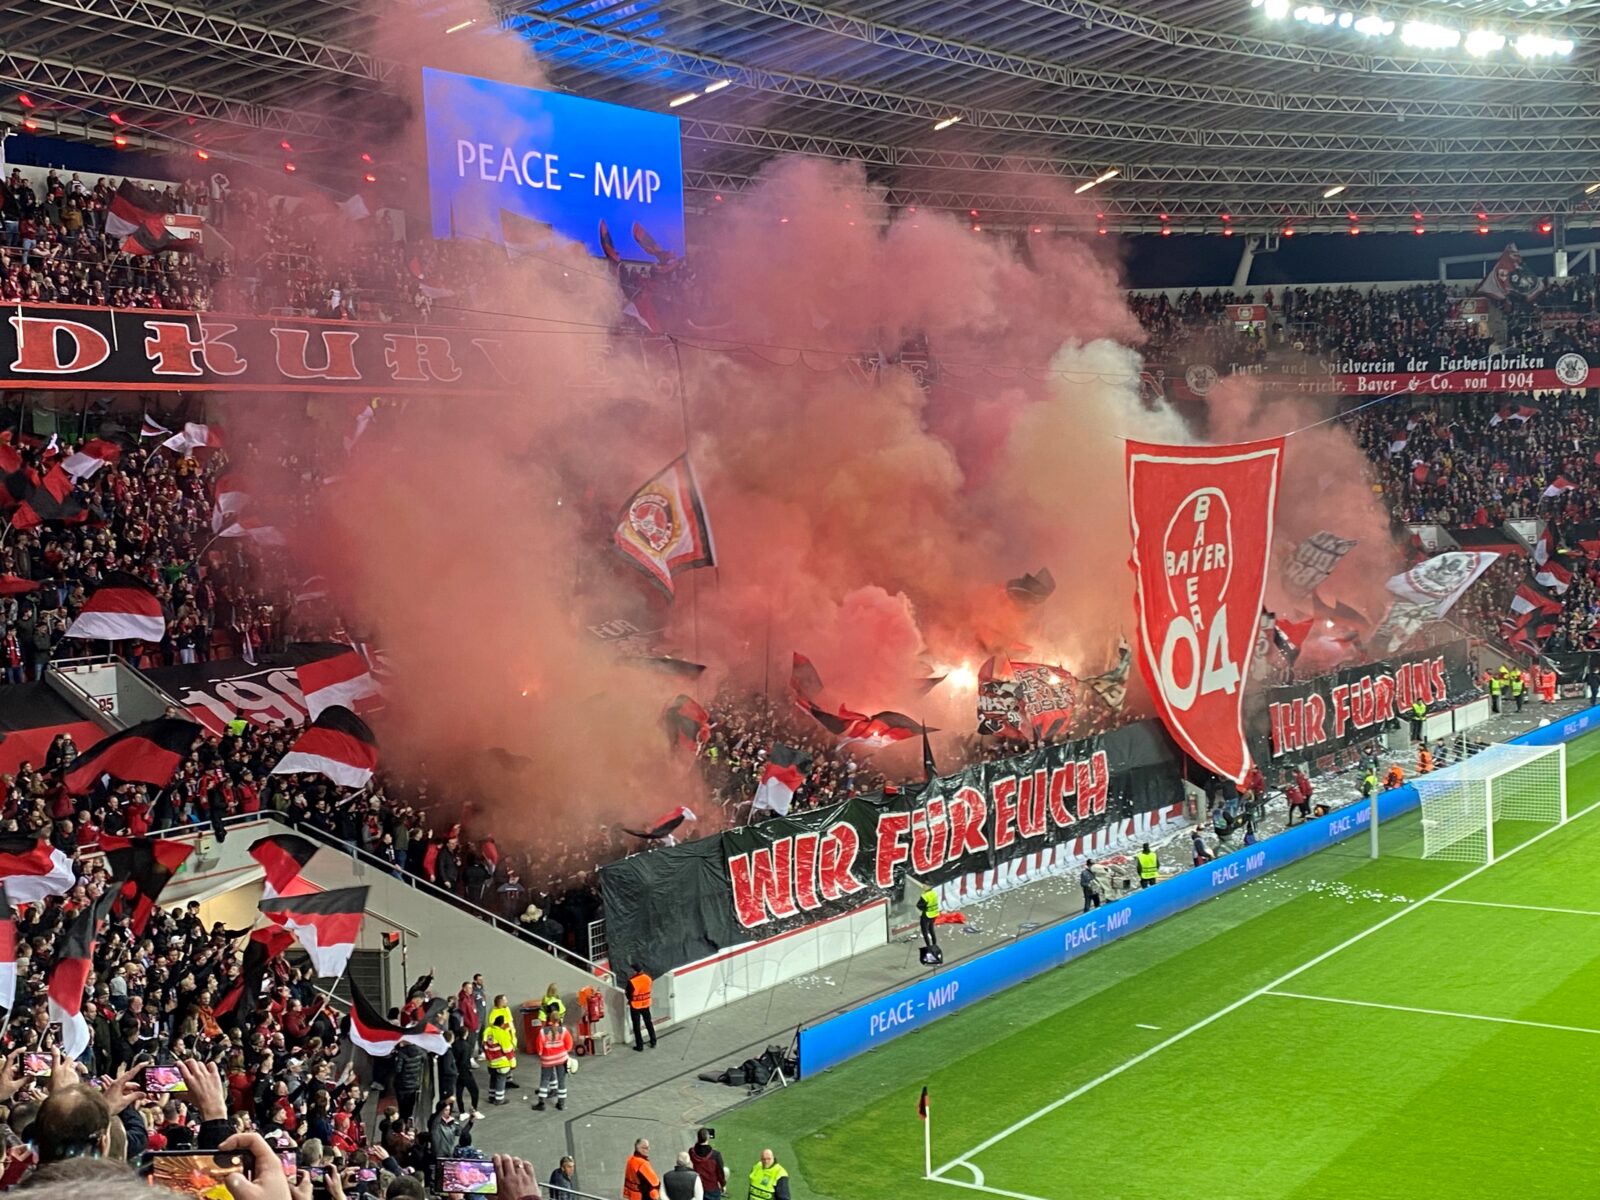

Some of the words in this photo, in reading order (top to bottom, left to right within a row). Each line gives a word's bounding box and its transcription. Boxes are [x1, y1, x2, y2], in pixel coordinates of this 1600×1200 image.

[457, 140, 562, 191] PEACE
[594, 162, 661, 203] МИР
[1281, 361, 1308, 375] und
[1319, 356, 1396, 379] Spielverein
[1406, 356, 1429, 372] der
[1440, 354, 1545, 375] Farbenfabriken
[1358, 376, 1397, 392] Bayer
[1430, 374, 1453, 390] Co.
[1464, 376, 1488, 389] von
[1500, 372, 1534, 388] 1904
[1166, 543, 1226, 577] BAYER
[1160, 603, 1241, 711] 04
[1269, 693, 1327, 758] IHR
[1332, 675, 1396, 739] FÜR
[1396, 655, 1447, 714] UNS
[728, 821, 868, 928] WIR
[876, 786, 989, 889] FÜR
[993, 749, 1110, 850] EUCH
[1212, 863, 1240, 886] PEACE
[1065, 920, 1098, 950] PEACE
[1107, 907, 1132, 932] МИР
[870, 1001, 915, 1036] PEACE
[928, 981, 959, 1011] МИР
